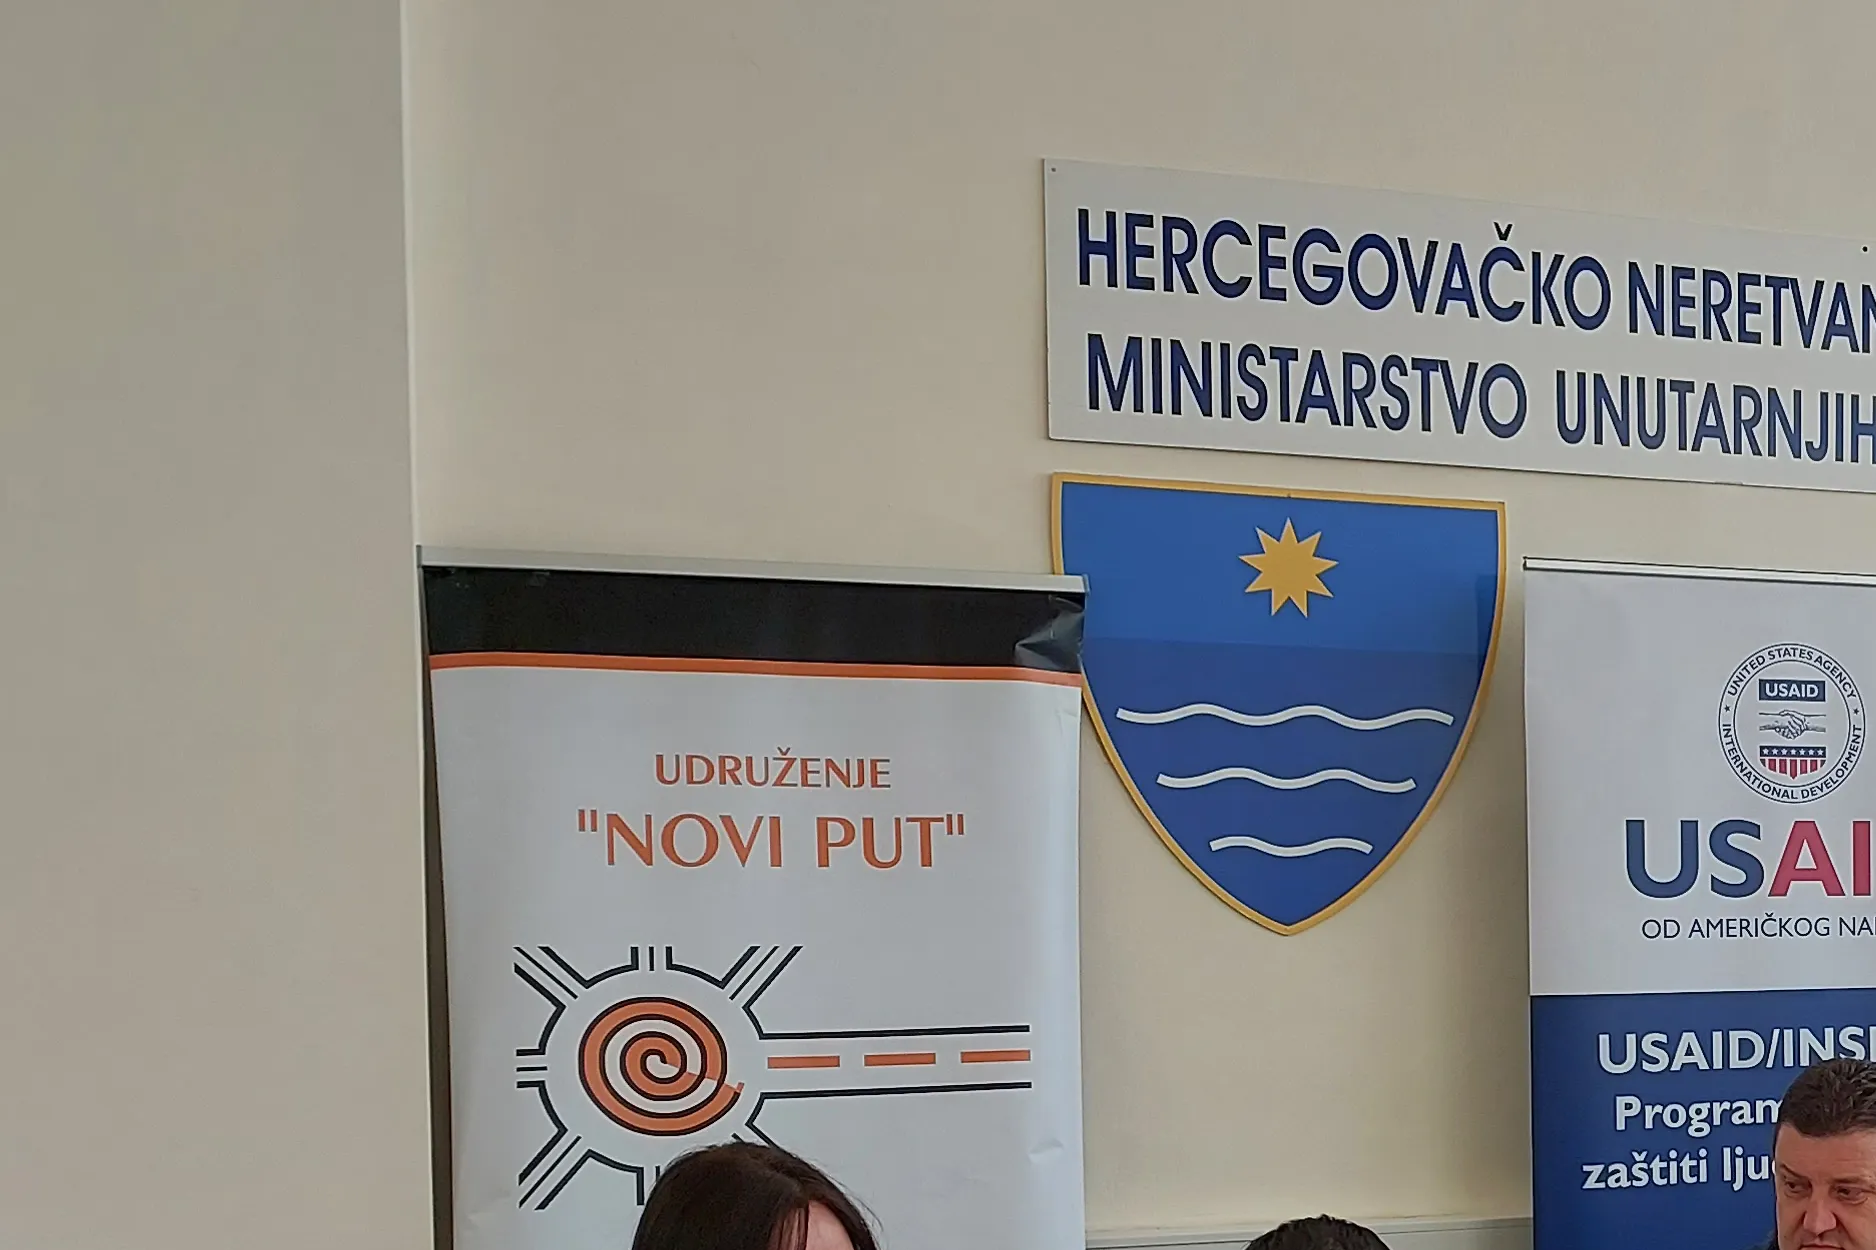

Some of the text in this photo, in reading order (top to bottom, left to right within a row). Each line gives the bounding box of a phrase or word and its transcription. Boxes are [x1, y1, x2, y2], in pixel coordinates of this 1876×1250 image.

[1077, 208, 1612, 331] HERCEGOVAČKO
[1087, 333, 1527, 438] MINISTARSTVO
[1728, 648, 1857, 699] UNITED STATES AGENCY
[1765, 683, 1819, 698] USAID
[655, 747, 891, 789] UDRUŽENJE
[1722, 723, 1862, 800] INTERNATIONAL DEVELOPMENT
[577, 809, 965, 868] "NOVI PUT"
[1641, 919, 1680, 940] OD
[1688, 913, 1831, 938] AMERIČKOG
[1582, 1148, 1708, 1190] zaštiti
